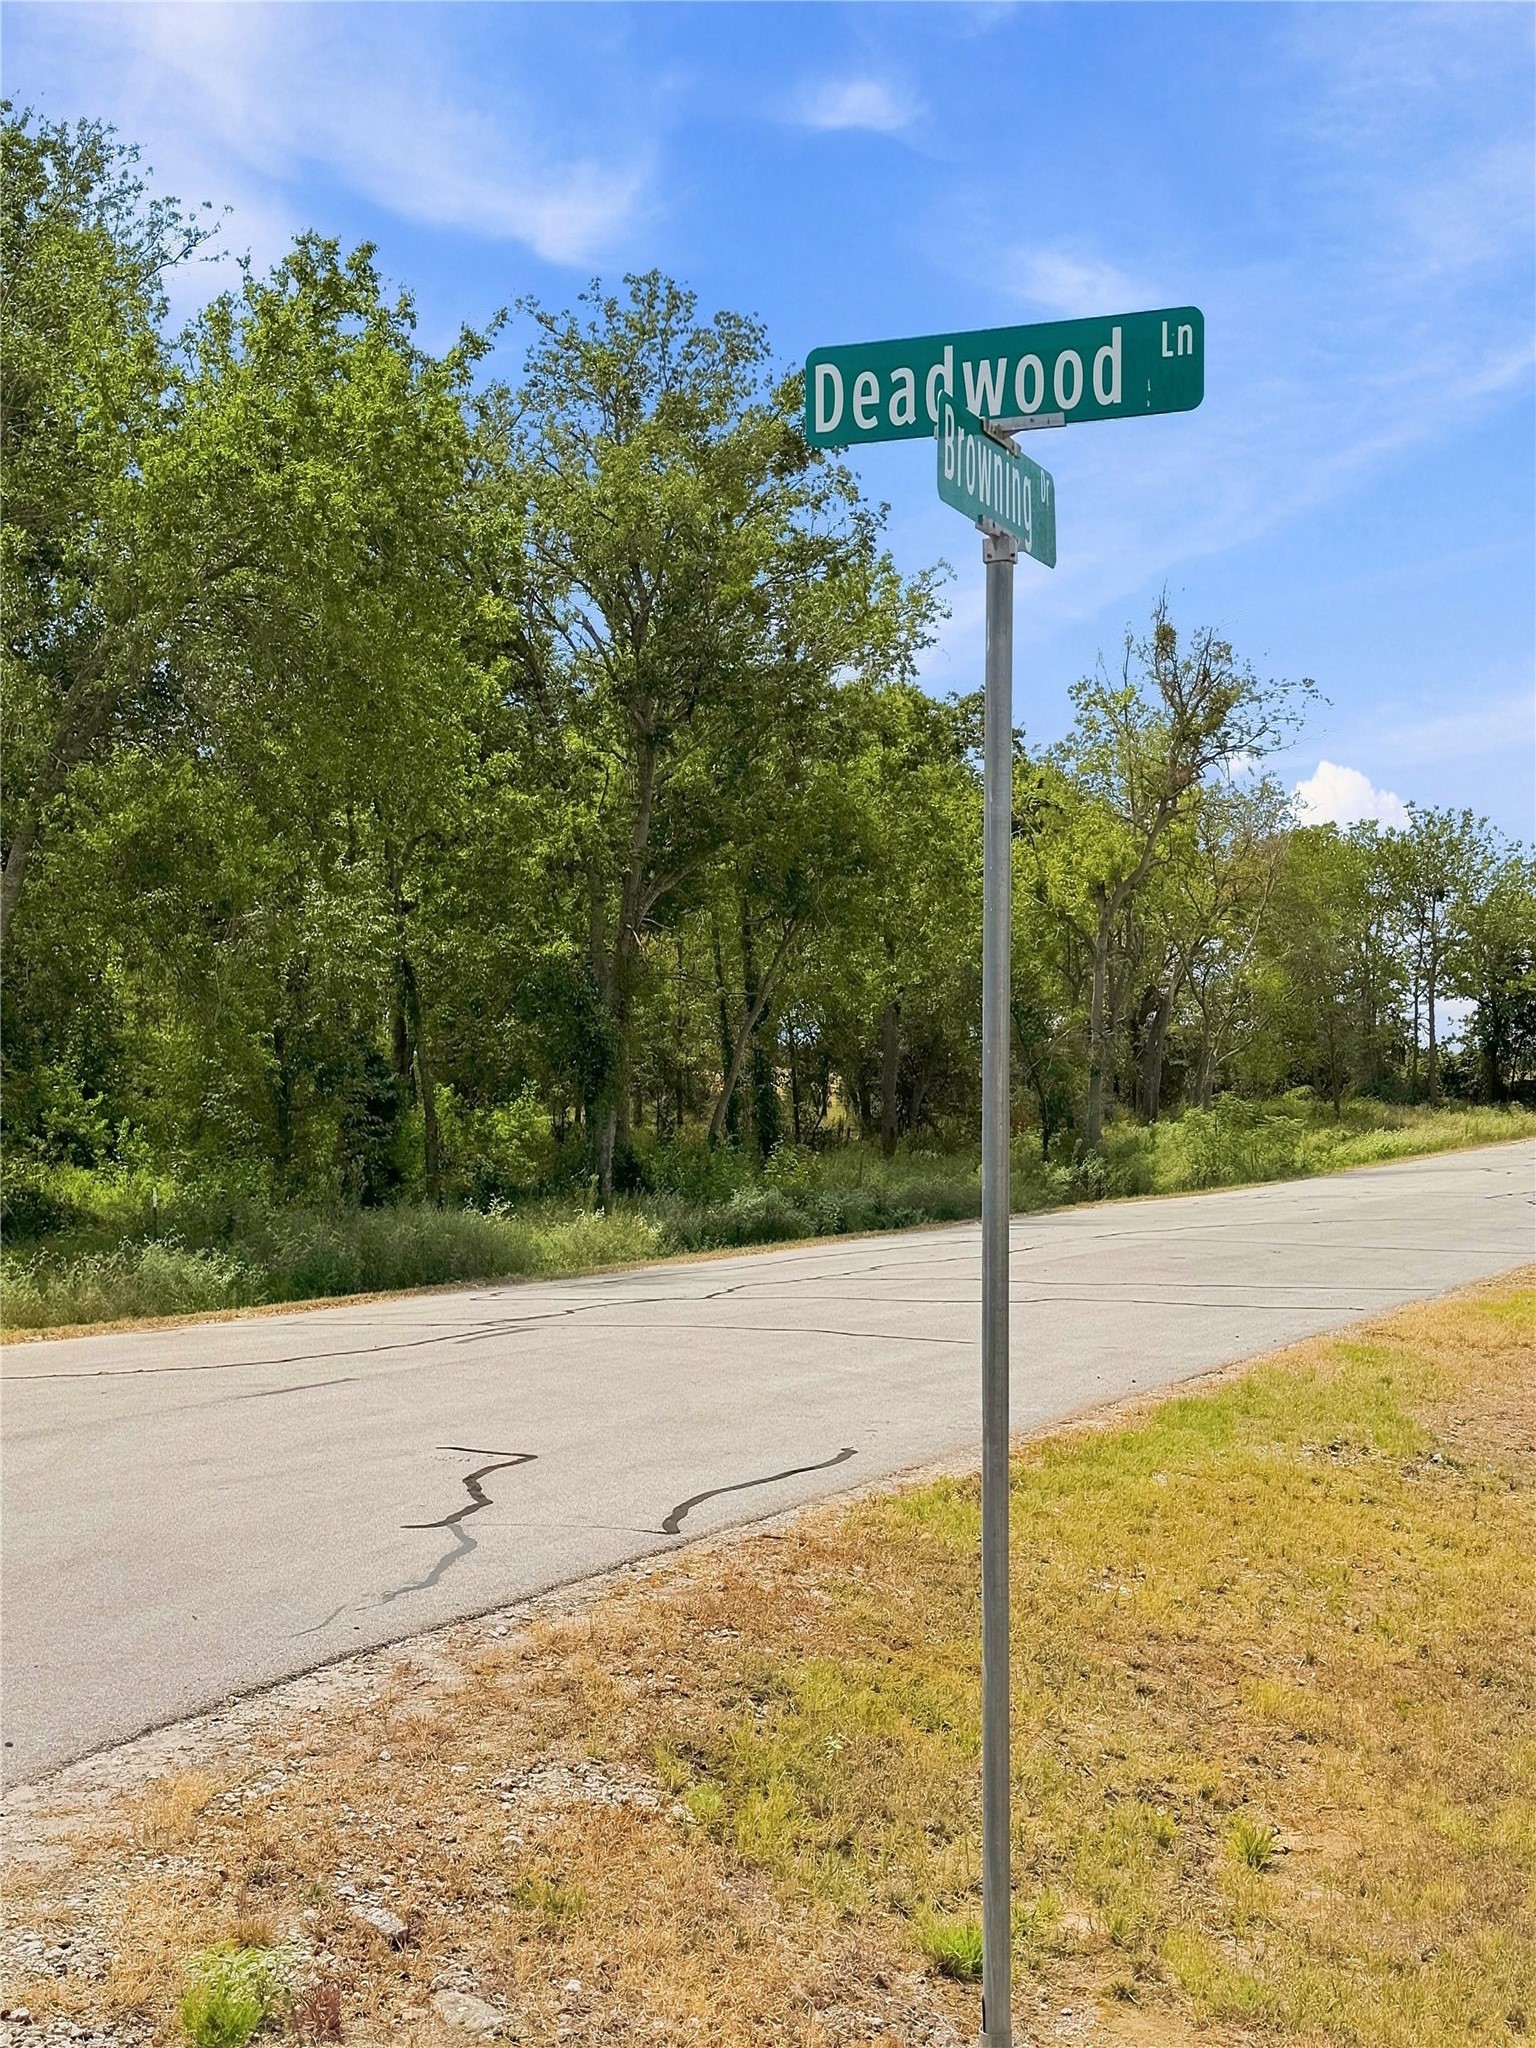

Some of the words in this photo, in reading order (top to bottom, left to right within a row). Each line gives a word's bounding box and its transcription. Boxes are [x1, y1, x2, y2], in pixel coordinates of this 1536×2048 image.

[815, 326, 1122, 433] Deadwood
[1162, 321, 1192, 357] Ln
[945, 403, 1032, 552] Browning
[1040, 469, 1050, 506] Dr
